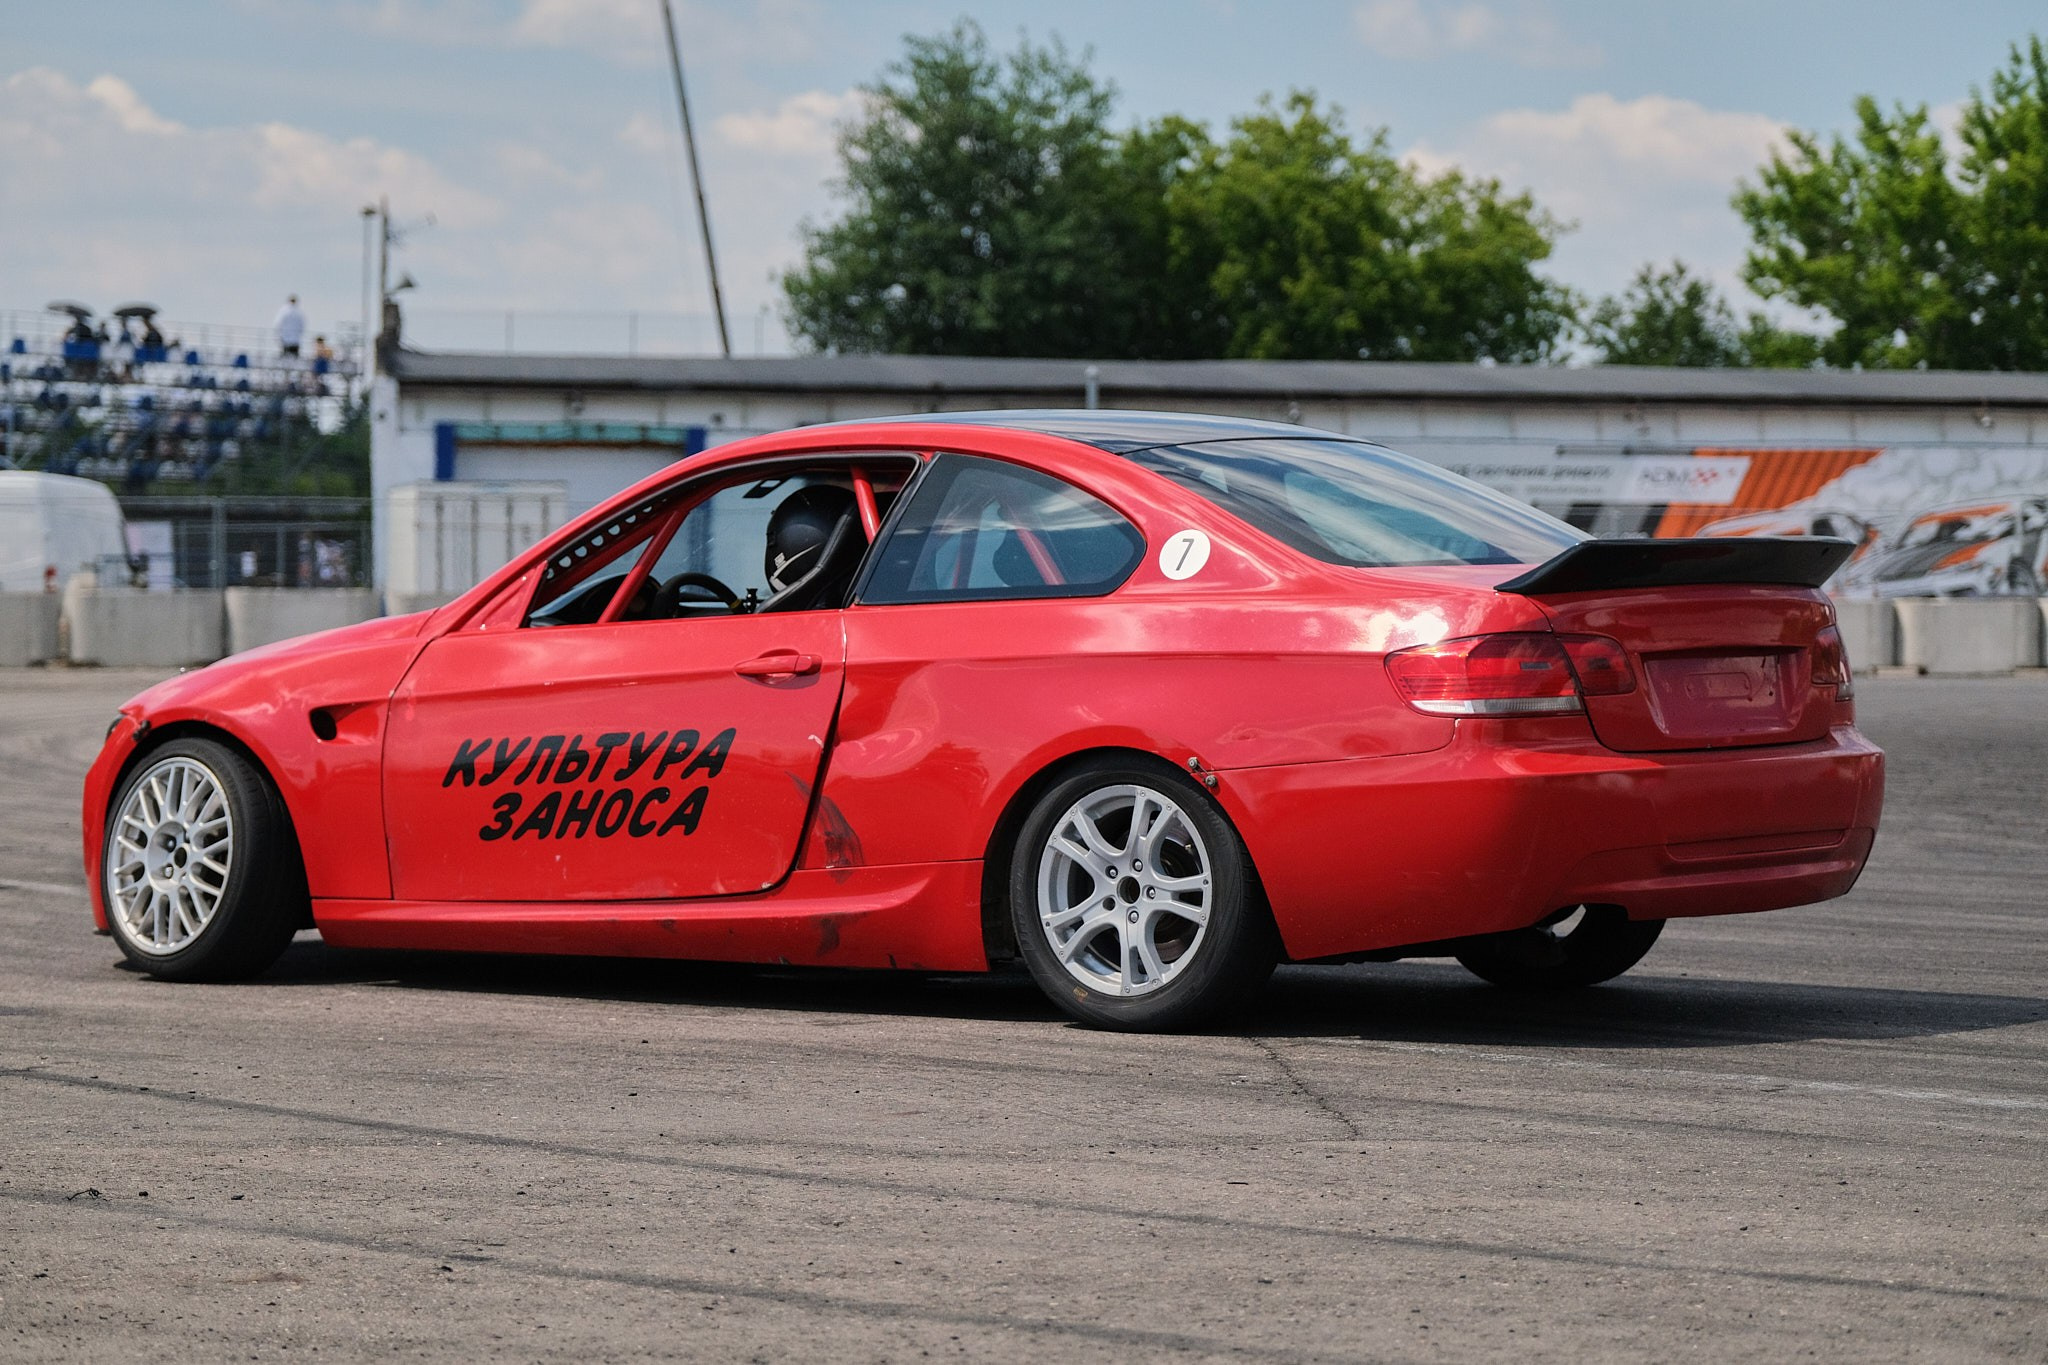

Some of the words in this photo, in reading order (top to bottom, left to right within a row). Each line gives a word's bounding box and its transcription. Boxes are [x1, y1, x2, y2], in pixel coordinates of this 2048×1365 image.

[1175, 538, 1195, 571] 7
[442, 728, 737, 788] КУЛЬТУРА
[479, 786, 709, 841] ЗАНОСА
